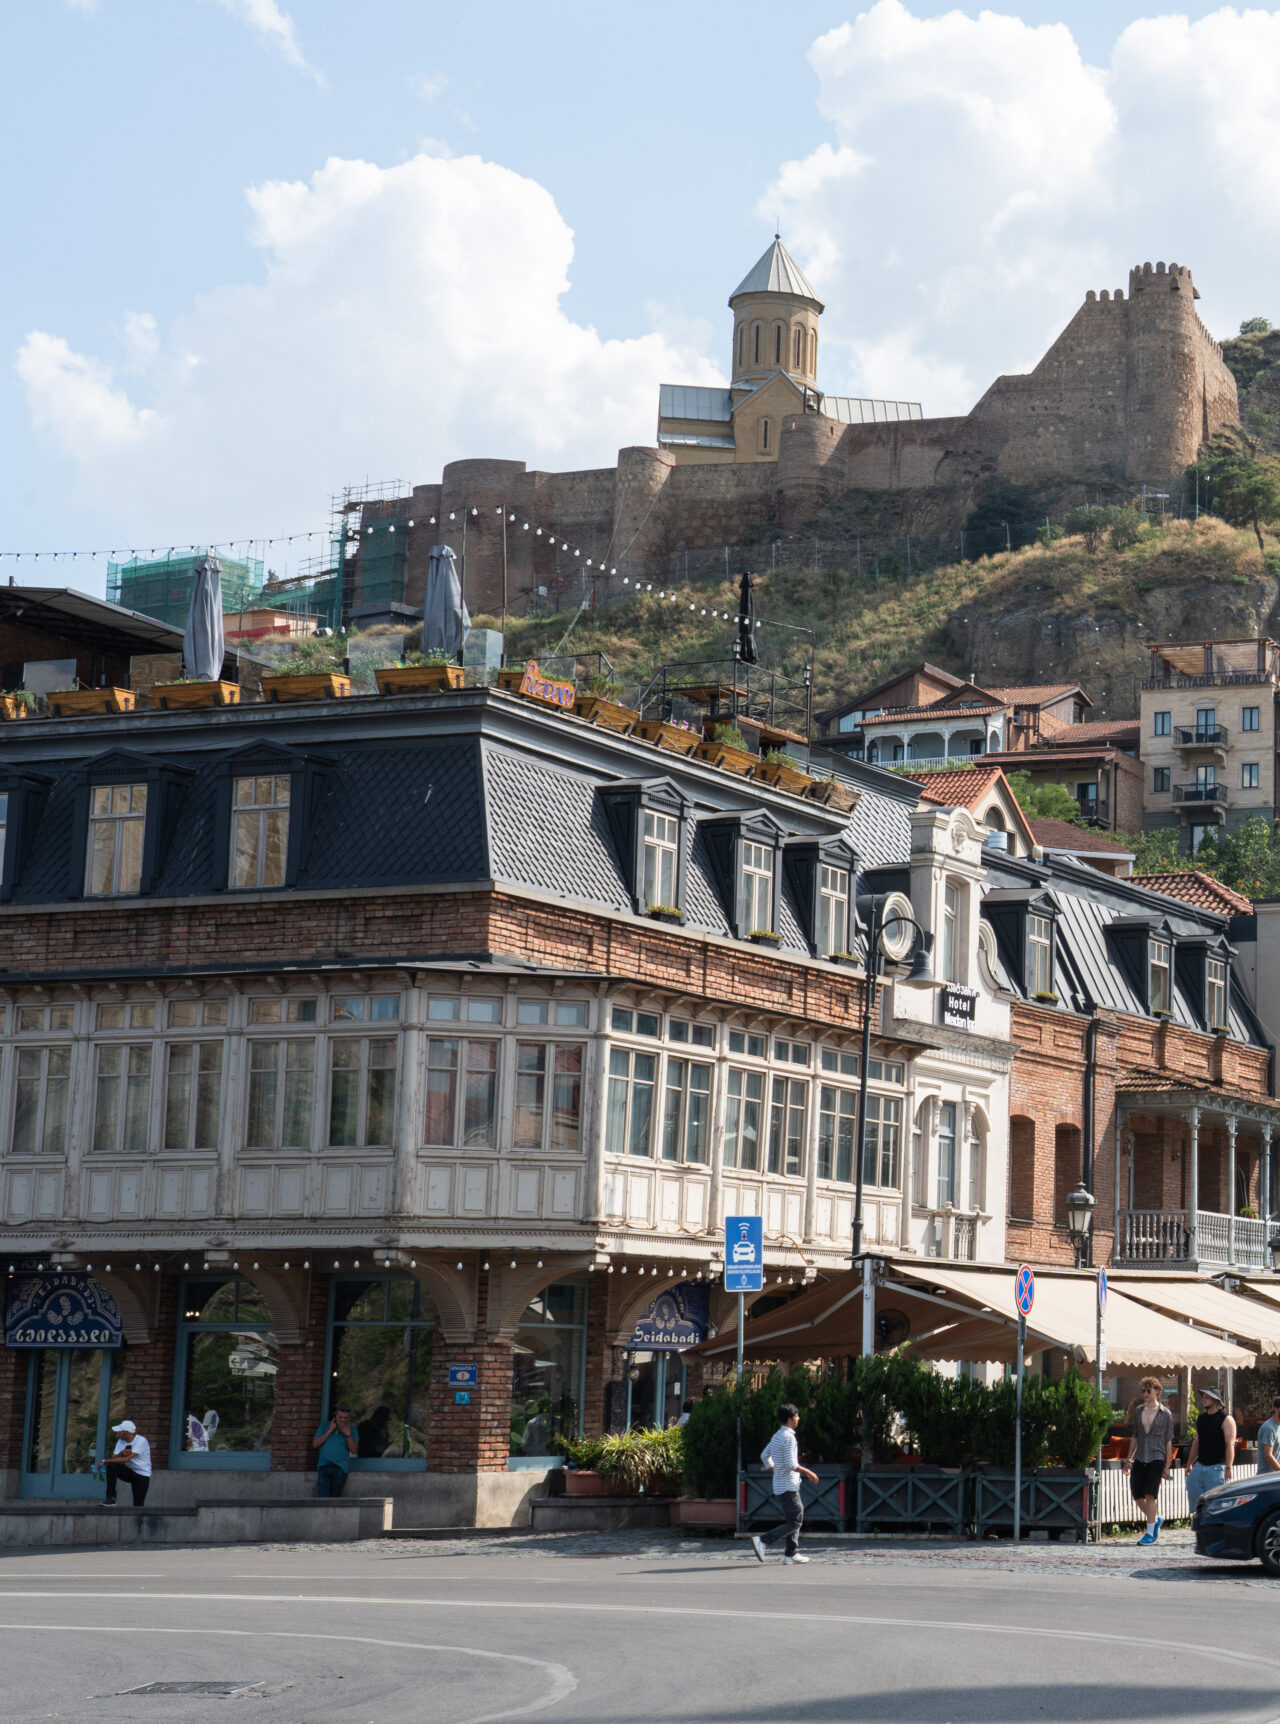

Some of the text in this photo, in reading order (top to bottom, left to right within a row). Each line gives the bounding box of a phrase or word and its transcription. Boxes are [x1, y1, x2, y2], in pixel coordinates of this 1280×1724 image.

[1141, 673, 1271, 690] HOTEL CITADEL NARIKALA
[949, 996, 970, 1011] Hotel
[944, 1011, 966, 1028] Meidan
[632, 1326, 700, 1344] Seidabadi
